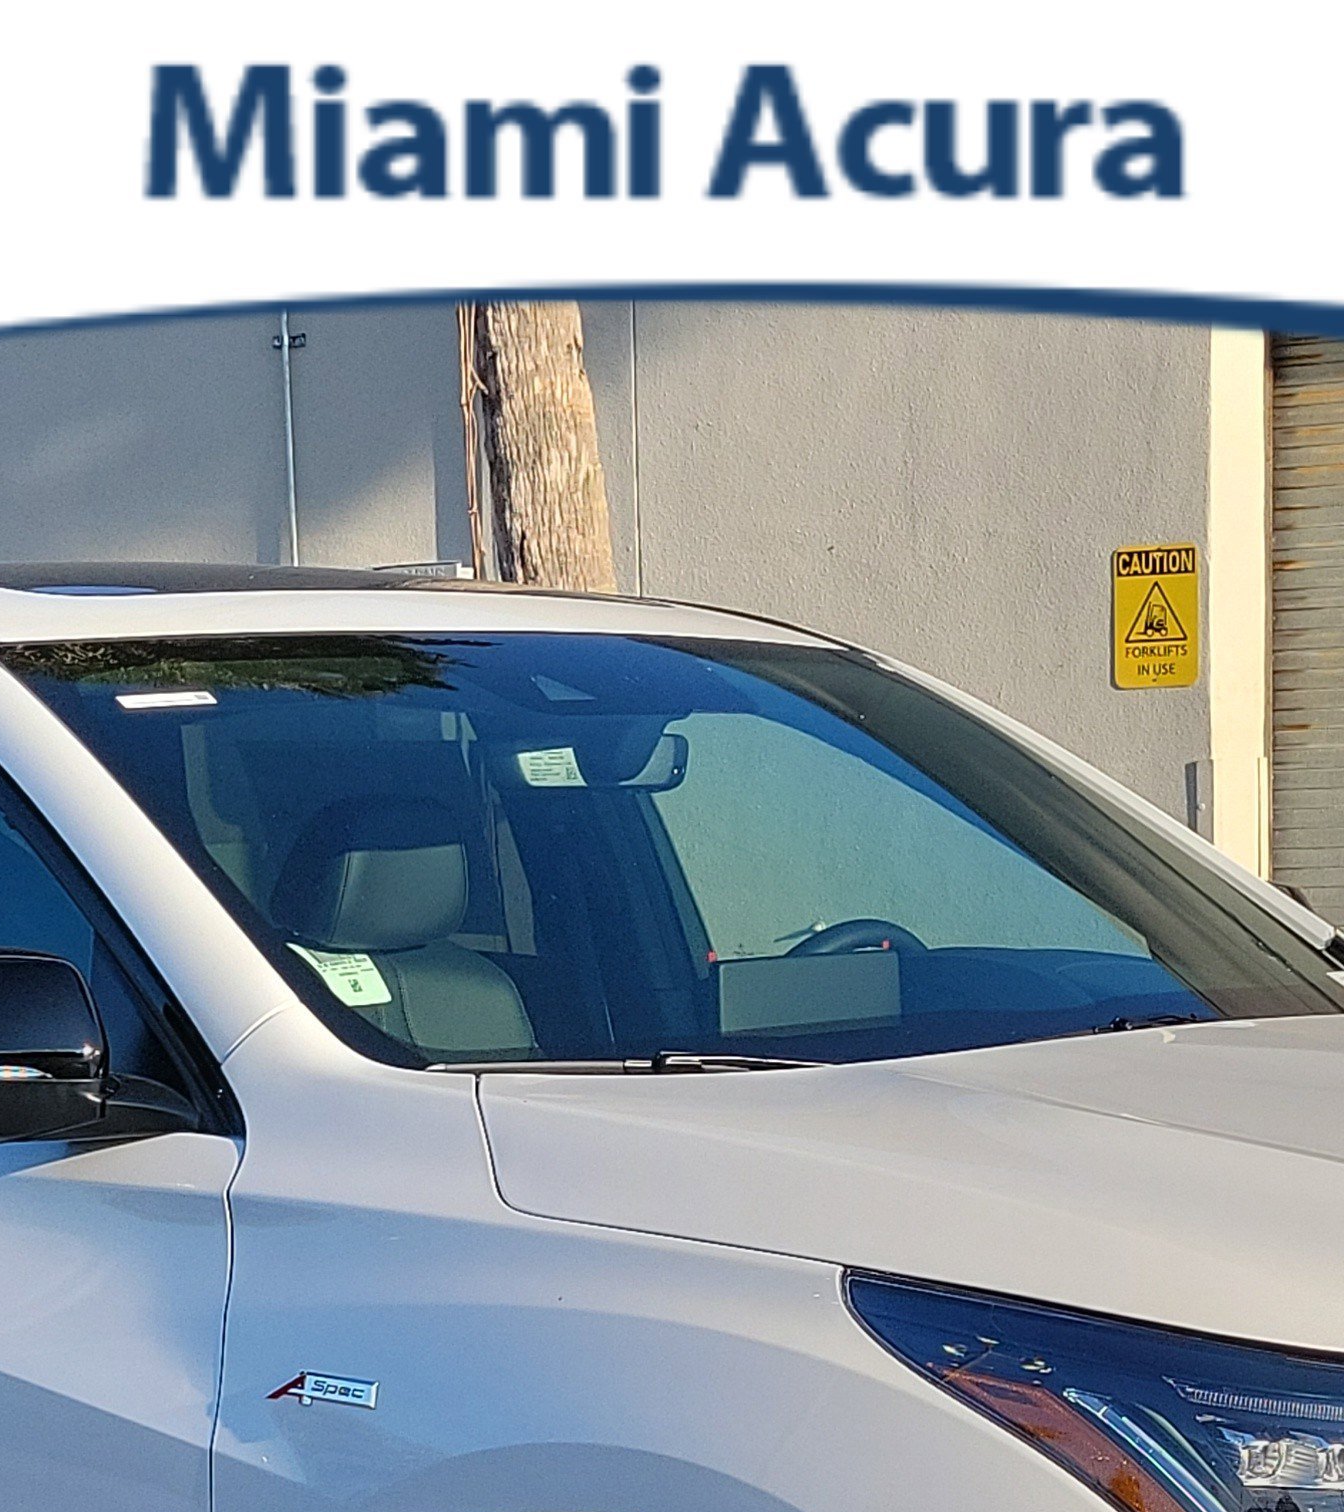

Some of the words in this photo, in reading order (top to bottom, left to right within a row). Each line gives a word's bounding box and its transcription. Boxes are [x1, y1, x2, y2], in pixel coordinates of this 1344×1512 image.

[1118, 550, 1193, 575] CAUTION
[1125, 644, 1188, 658] FORKLIFTS
[1137, 664, 1150, 676] IN
[1153, 663, 1176, 675] USE
